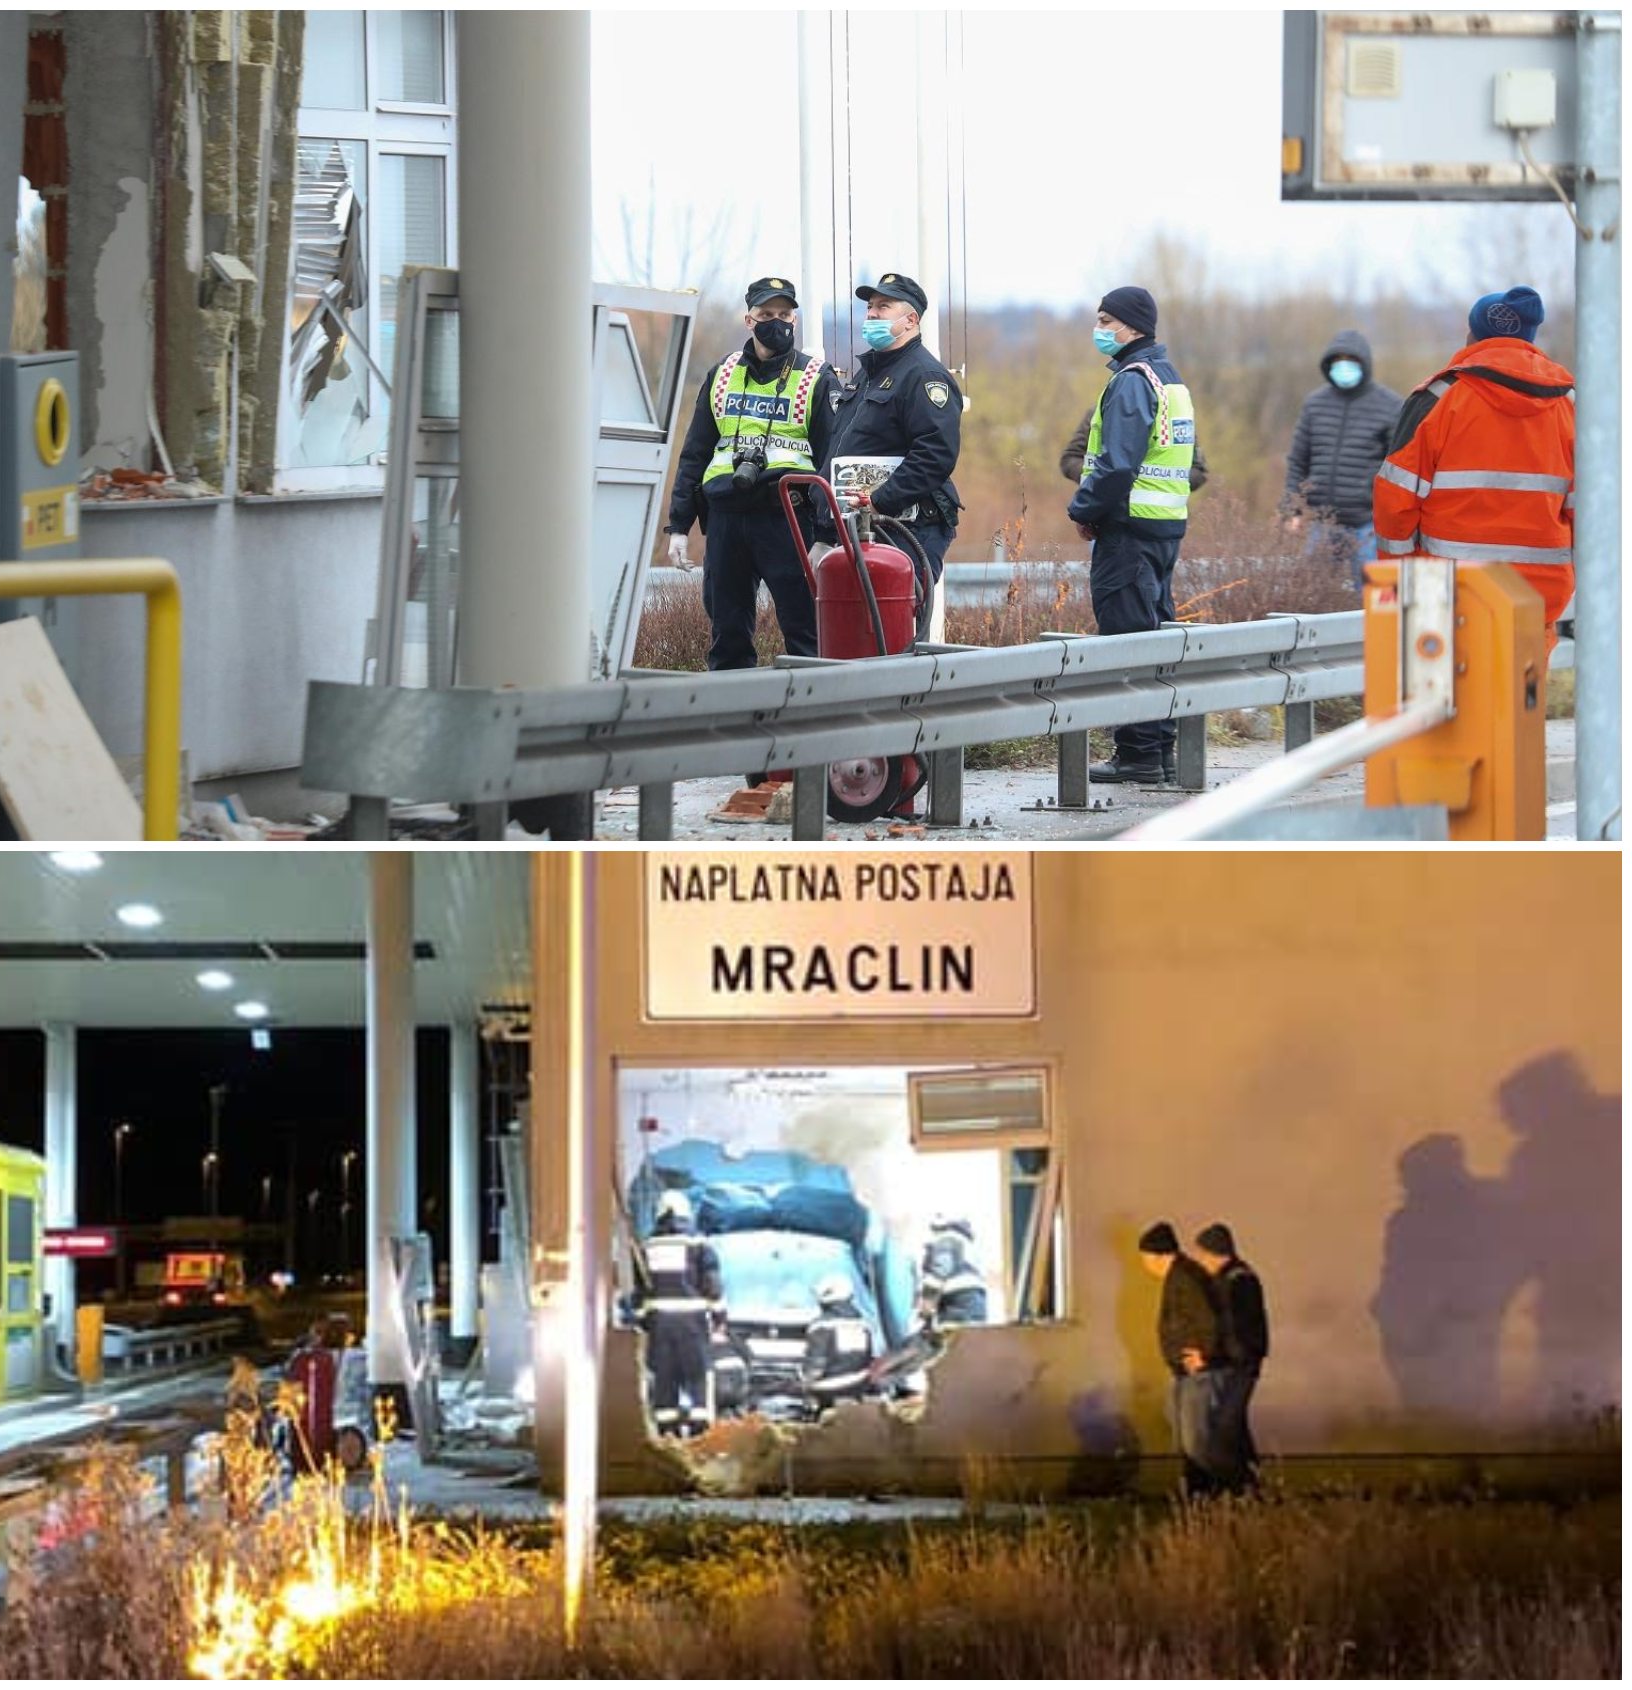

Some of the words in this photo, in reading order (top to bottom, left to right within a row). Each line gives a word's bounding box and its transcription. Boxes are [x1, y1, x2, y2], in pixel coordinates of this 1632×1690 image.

[727, 398, 785, 416] POLICIJA
[769, 437, 810, 453] POLICIJA
[1138, 465, 1171, 478] OLICIJA
[660, 863, 841, 901] NAPLATNA
[856, 862, 1014, 901] POSTAJA
[712, 944, 974, 992] MRACLIN
